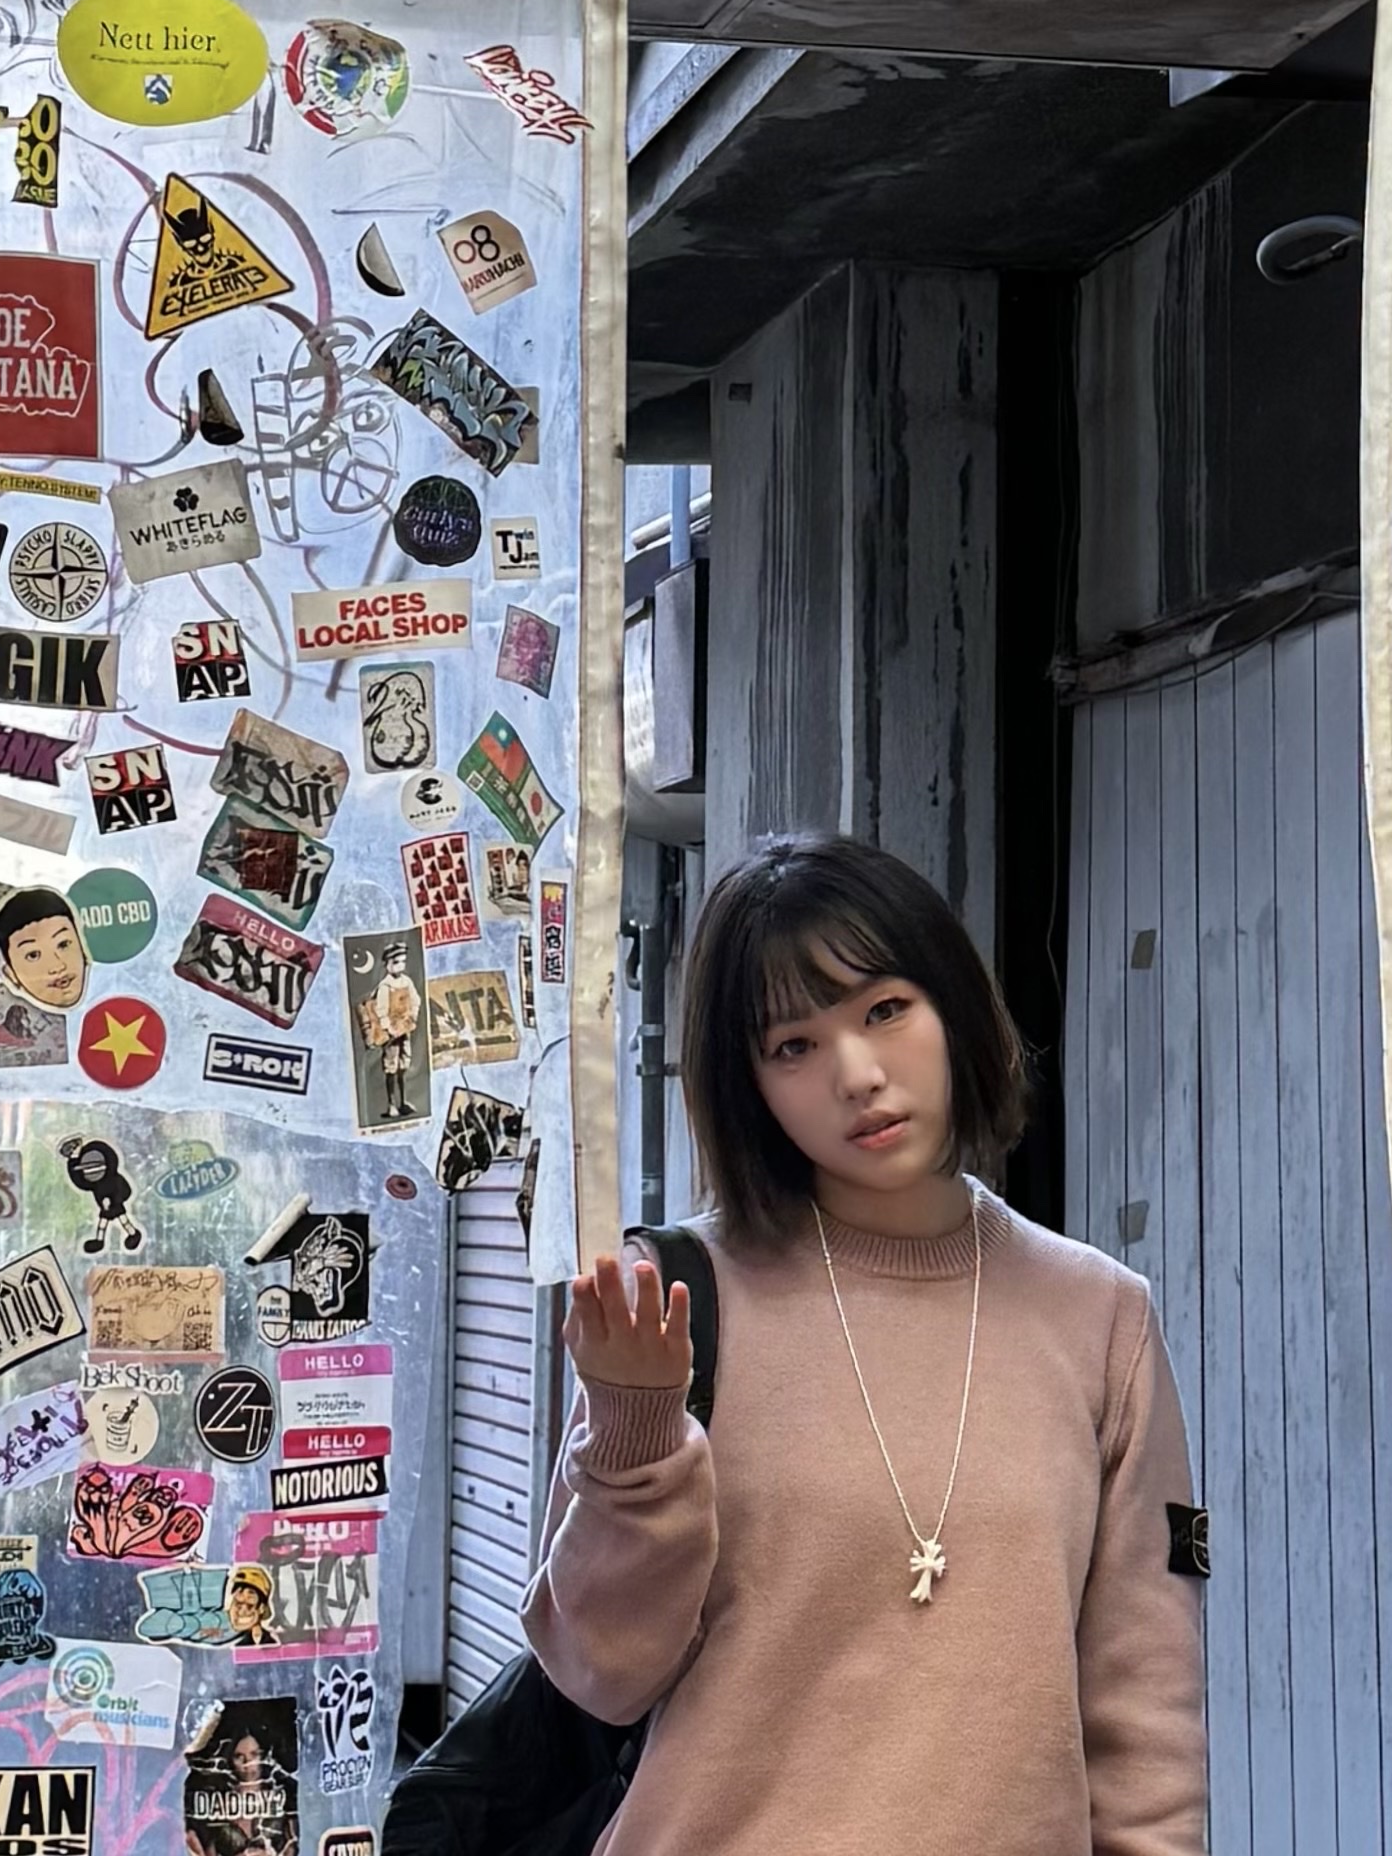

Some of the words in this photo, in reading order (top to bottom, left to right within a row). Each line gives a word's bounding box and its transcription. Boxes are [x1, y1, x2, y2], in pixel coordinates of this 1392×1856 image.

[99, 22, 154, 52] Nett
[128, 506, 249, 547] WHITEFLAG
[337, 591, 428, 621] FACES
[297, 617, 390, 651] LOCAL
[391, 613, 469, 640] SHOP
[79, 906, 114, 929] ADD
[117, 899, 152, 926] CBD
[233, 909, 298, 951] HELLO
[304, 1353, 365, 1371] HELLO
[307, 1432, 368, 1451] HELLO
[273, 1460, 380, 1507] NOTORIOUS
[96, 1694, 140, 1713] Orbit
[94, 1711, 170, 1729] musicians
[192, 1788, 287, 1821] DADDY?
